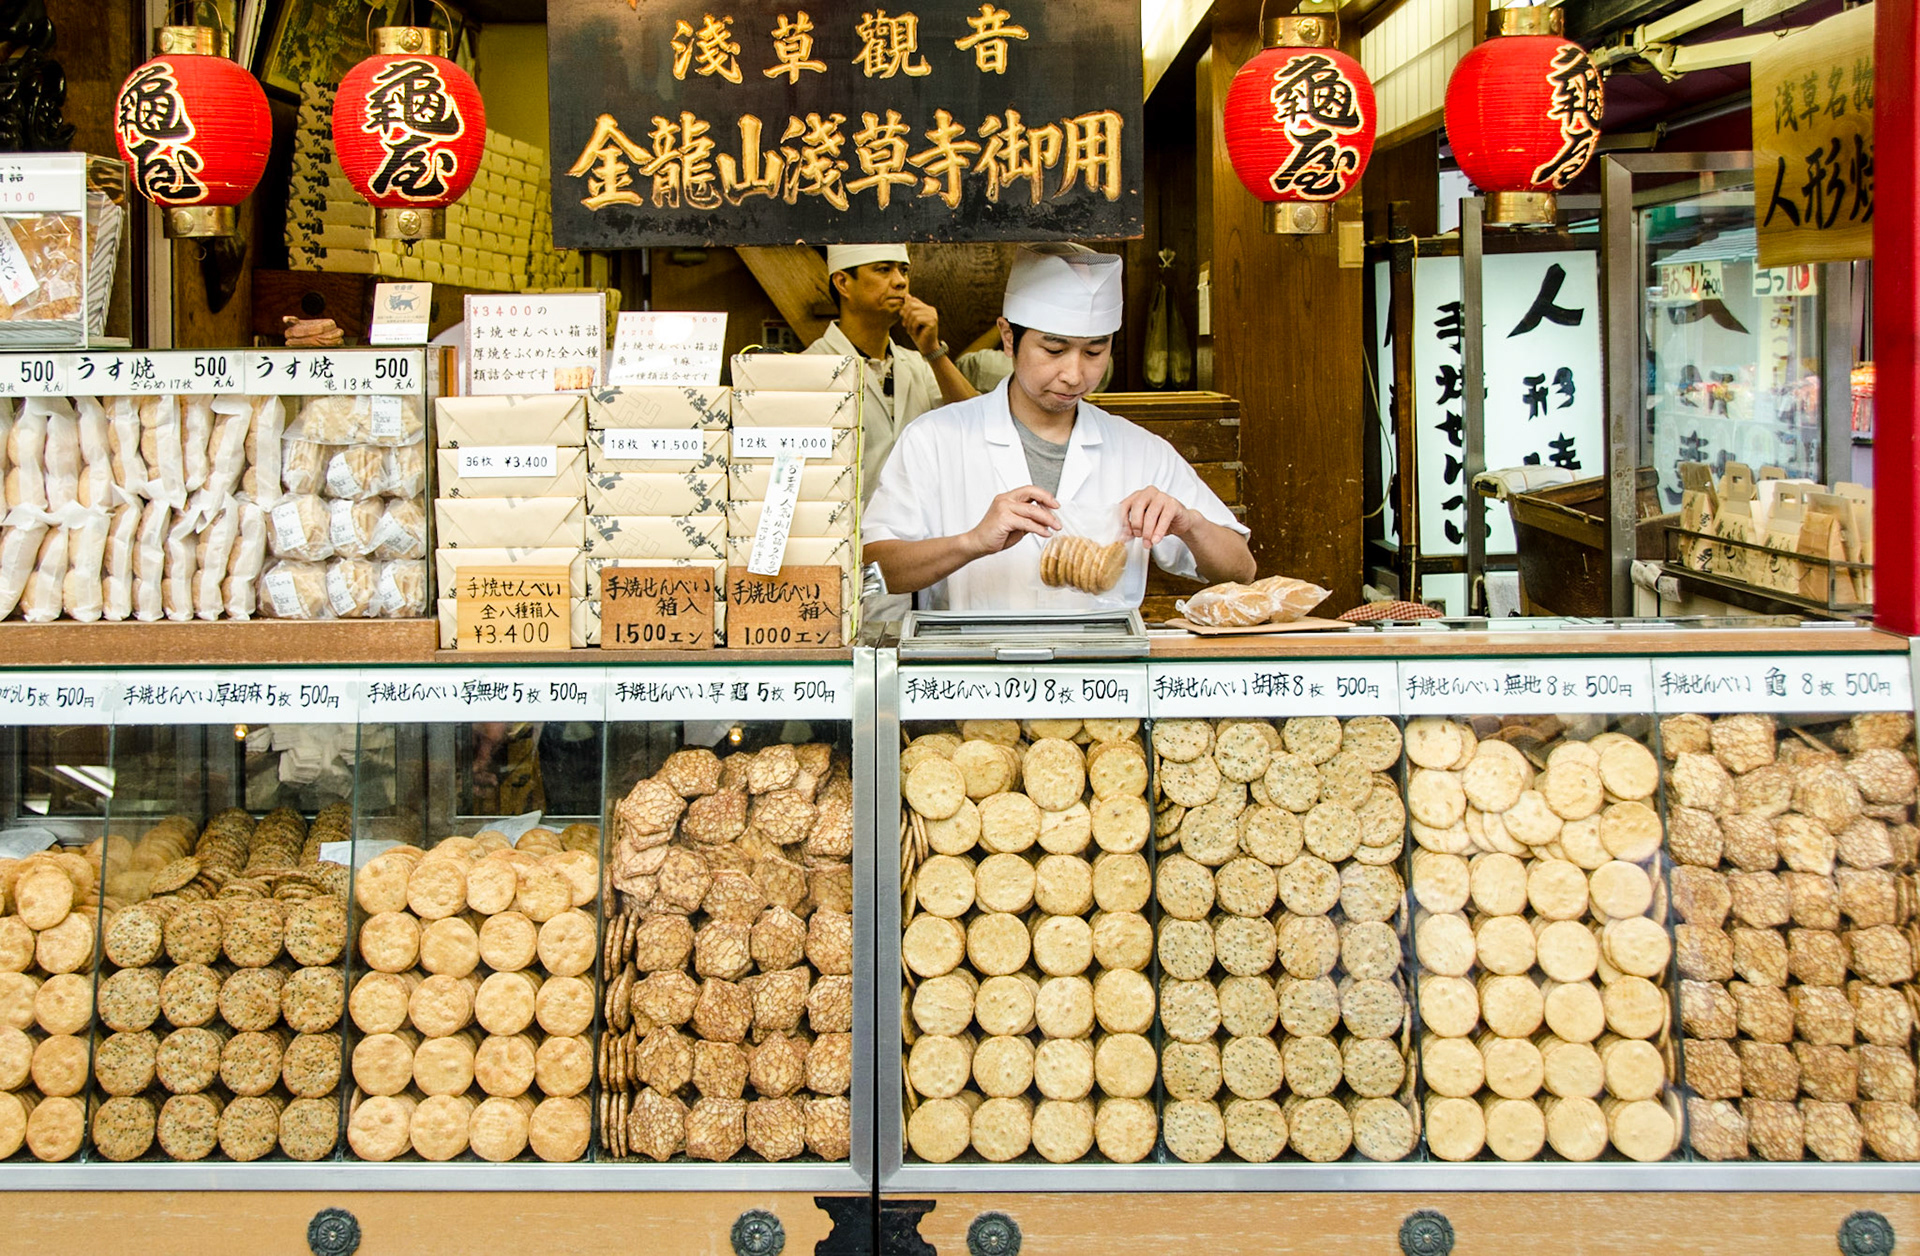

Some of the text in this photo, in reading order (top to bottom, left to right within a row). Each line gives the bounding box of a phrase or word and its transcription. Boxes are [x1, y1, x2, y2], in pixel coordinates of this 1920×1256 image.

[473, 325, 598, 339] 手焼せんべい箱詰
[21, 360, 54, 382] 500
[77, 356, 156, 381] うす焼
[194, 356, 226, 377] 500
[256, 355, 334, 379] うす焼
[375, 357, 408, 379] 500
[43, 382, 63, 392] えん
[213, 375, 234, 387] えん
[394, 379, 415, 390] えん
[467, 577, 561, 598] 手焼せんべい
[605, 576, 711, 600] 手焼せんべい
[731, 579, 820, 605] 手焼せんべい
[480, 602, 560, 620] 全八種箱入
[656, 597, 706, 617] 箱入
[800, 601, 839, 622] 箱入
